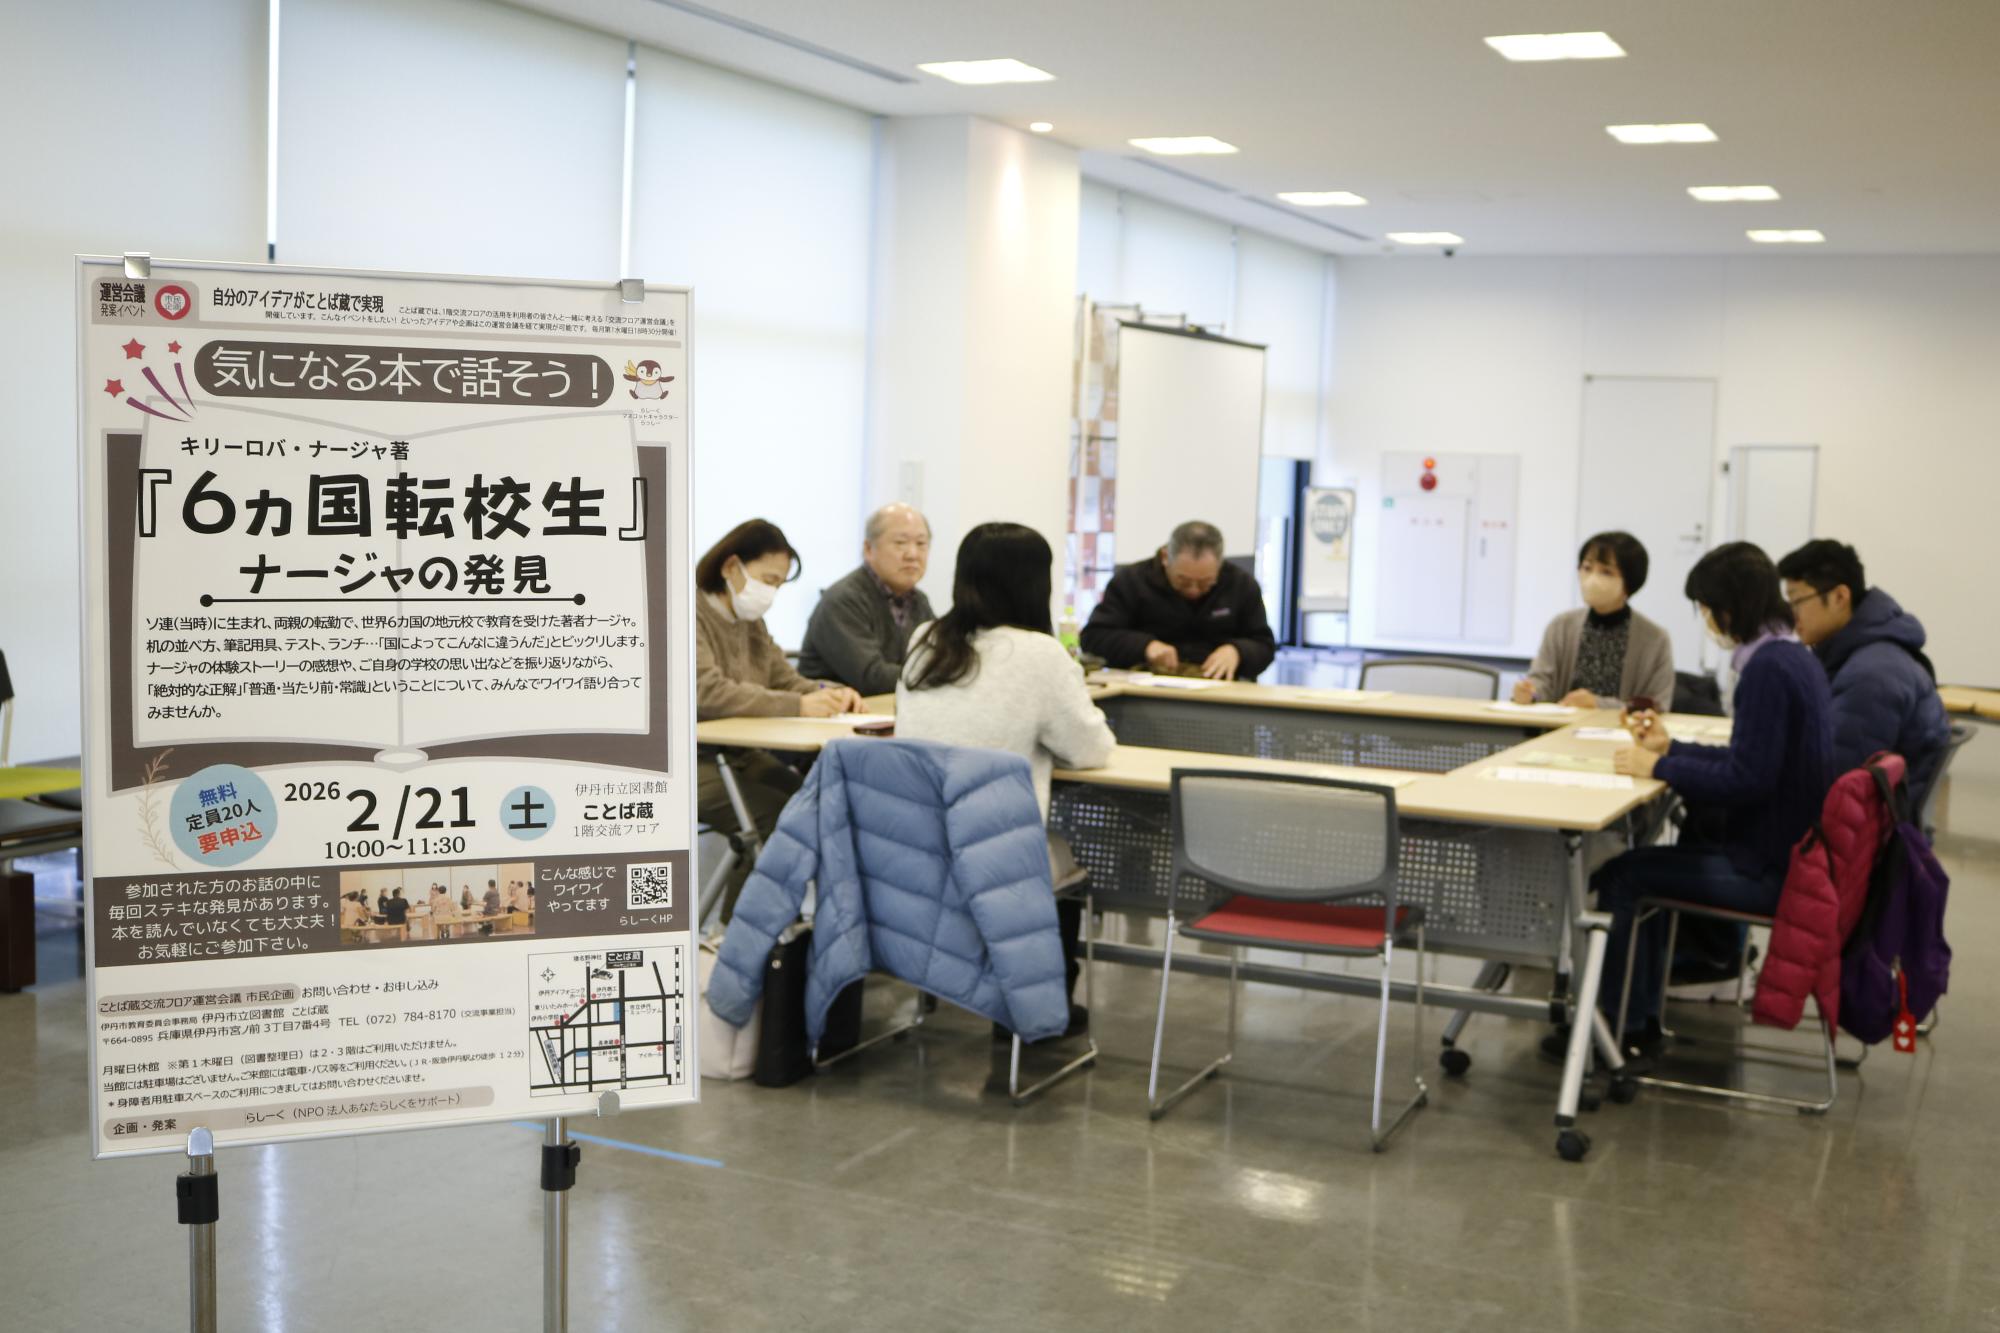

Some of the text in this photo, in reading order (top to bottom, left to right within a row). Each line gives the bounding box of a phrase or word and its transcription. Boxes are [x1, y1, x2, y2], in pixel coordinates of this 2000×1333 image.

[100, 282, 146, 304] 運営会議
[213, 287, 384, 313] 自分のアイデアがことば蔵で実現
[100, 303, 146, 317] 発案イベント
[211, 346, 600, 400] 気になる本で話そう！
[180, 437, 410, 461] キリーロバ・ナージャ著
[239, 552, 552, 594] ナージャの発見
[147, 705, 222, 720] みませんか。
[198, 781, 238, 808] 無料
[575, 781, 668, 796] 伊丹市立図書館
[185, 799, 262, 832] 定員20人
[285, 781, 341, 801] 2026
[508, 791, 547, 829] 土
[583, 802, 654, 820] ことば蔵
[197, 822, 263, 855] 要申込
[574, 823, 660, 838] 1階交流フロア
[541, 865, 616, 881] こんな感じで
[125, 875, 321, 899] 参加された方のお話の中に
[554, 882, 604, 897] ワイワイ
[108, 894, 330, 921] 毎回ステキな発見があります。
[546, 897, 610, 913] やってます
[111, 913, 335, 941] 本を読んでいなくても大丈夫！
[619, 913, 673, 926] らしーくHP
[138, 937, 309, 960] お気軽にご参加下さい。
[100, 979, 440, 1013] ことば蔵交流フロア運営会議 市民企画 お問い合わせ・お申し込み
[202, 1008, 285, 1023] 伊丹市立図書館
[292, 1004, 329, 1017] ことば蔵
[338, 1018, 359, 1027] TEL
[404, 1008, 456, 1022] 784-8170
[103, 1062, 160, 1076] 月曜日休館
[113, 1118, 176, 1135] 企画・発案
